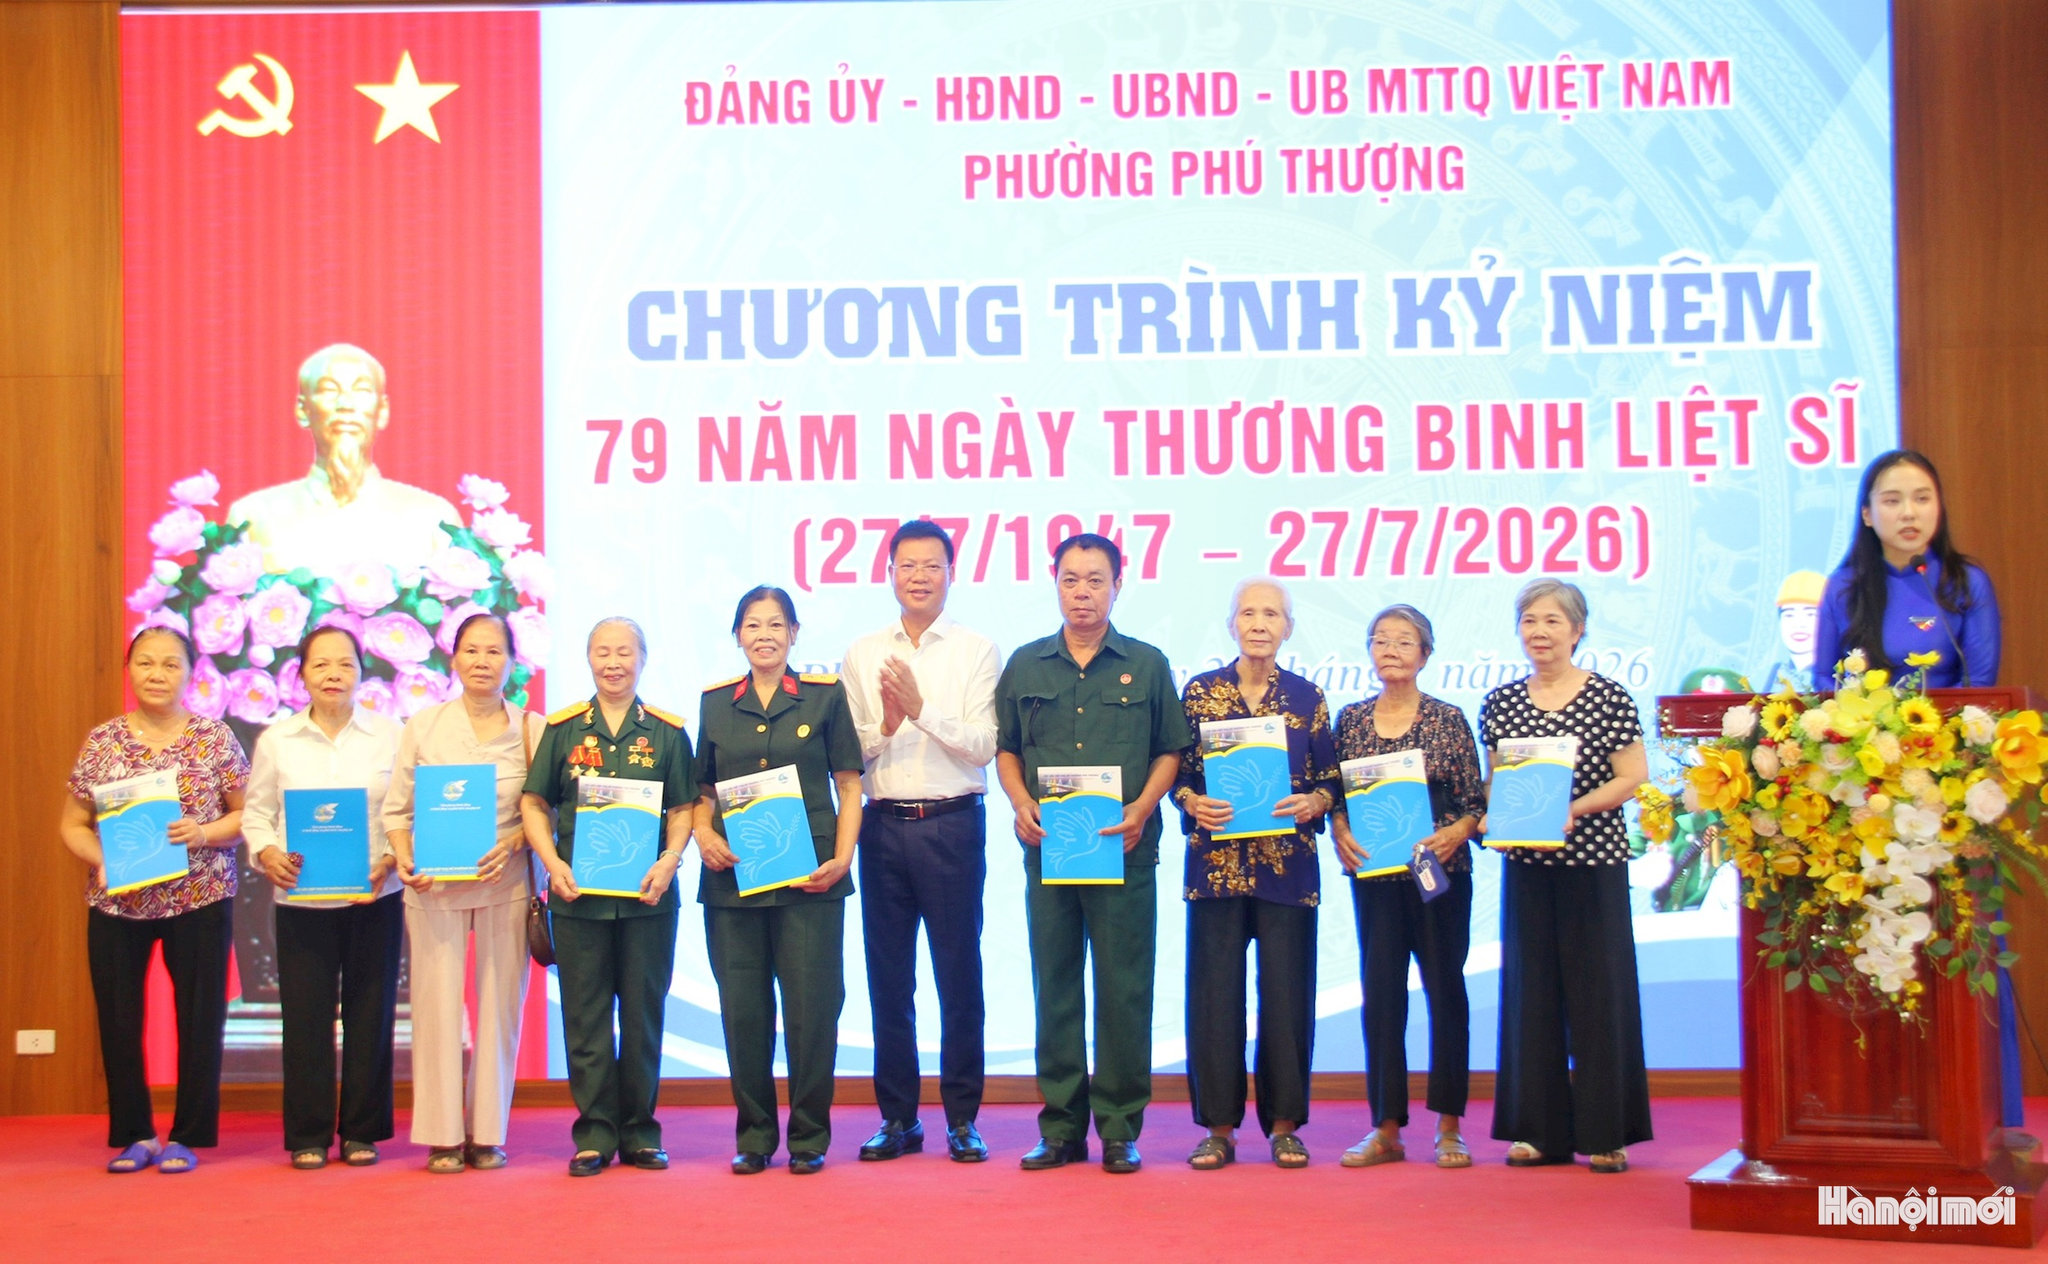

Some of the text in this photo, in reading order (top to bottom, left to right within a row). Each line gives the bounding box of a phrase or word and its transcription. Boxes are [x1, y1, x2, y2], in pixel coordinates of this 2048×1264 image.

[685, 64, 810, 125] ĐẢNG
[830, 63, 884, 123] ỦY
[937, 75, 1061, 121] HĐND
[1113, 72, 1238, 118] UBND
[1290, 70, 1348, 115] UB
[1368, 66, 1490, 117] MTTQ
[1508, 54, 1604, 120] VIỆT
[1623, 61, 1730, 108] NAM
[965, 140, 1465, 204] PHƯỜNG PHÚ THƯỢNG
[628, 255, 1813, 361] CHƯƠNG TRÌNH KỶ NIỆM
[586, 383, 1859, 484] 79 NĂM NGÀY THƯƠNG BINH LIỆT SĨ
[794, 513, 1171, 592] (277/17
[1268, 506, 1650, 579] 27/7/2026)
